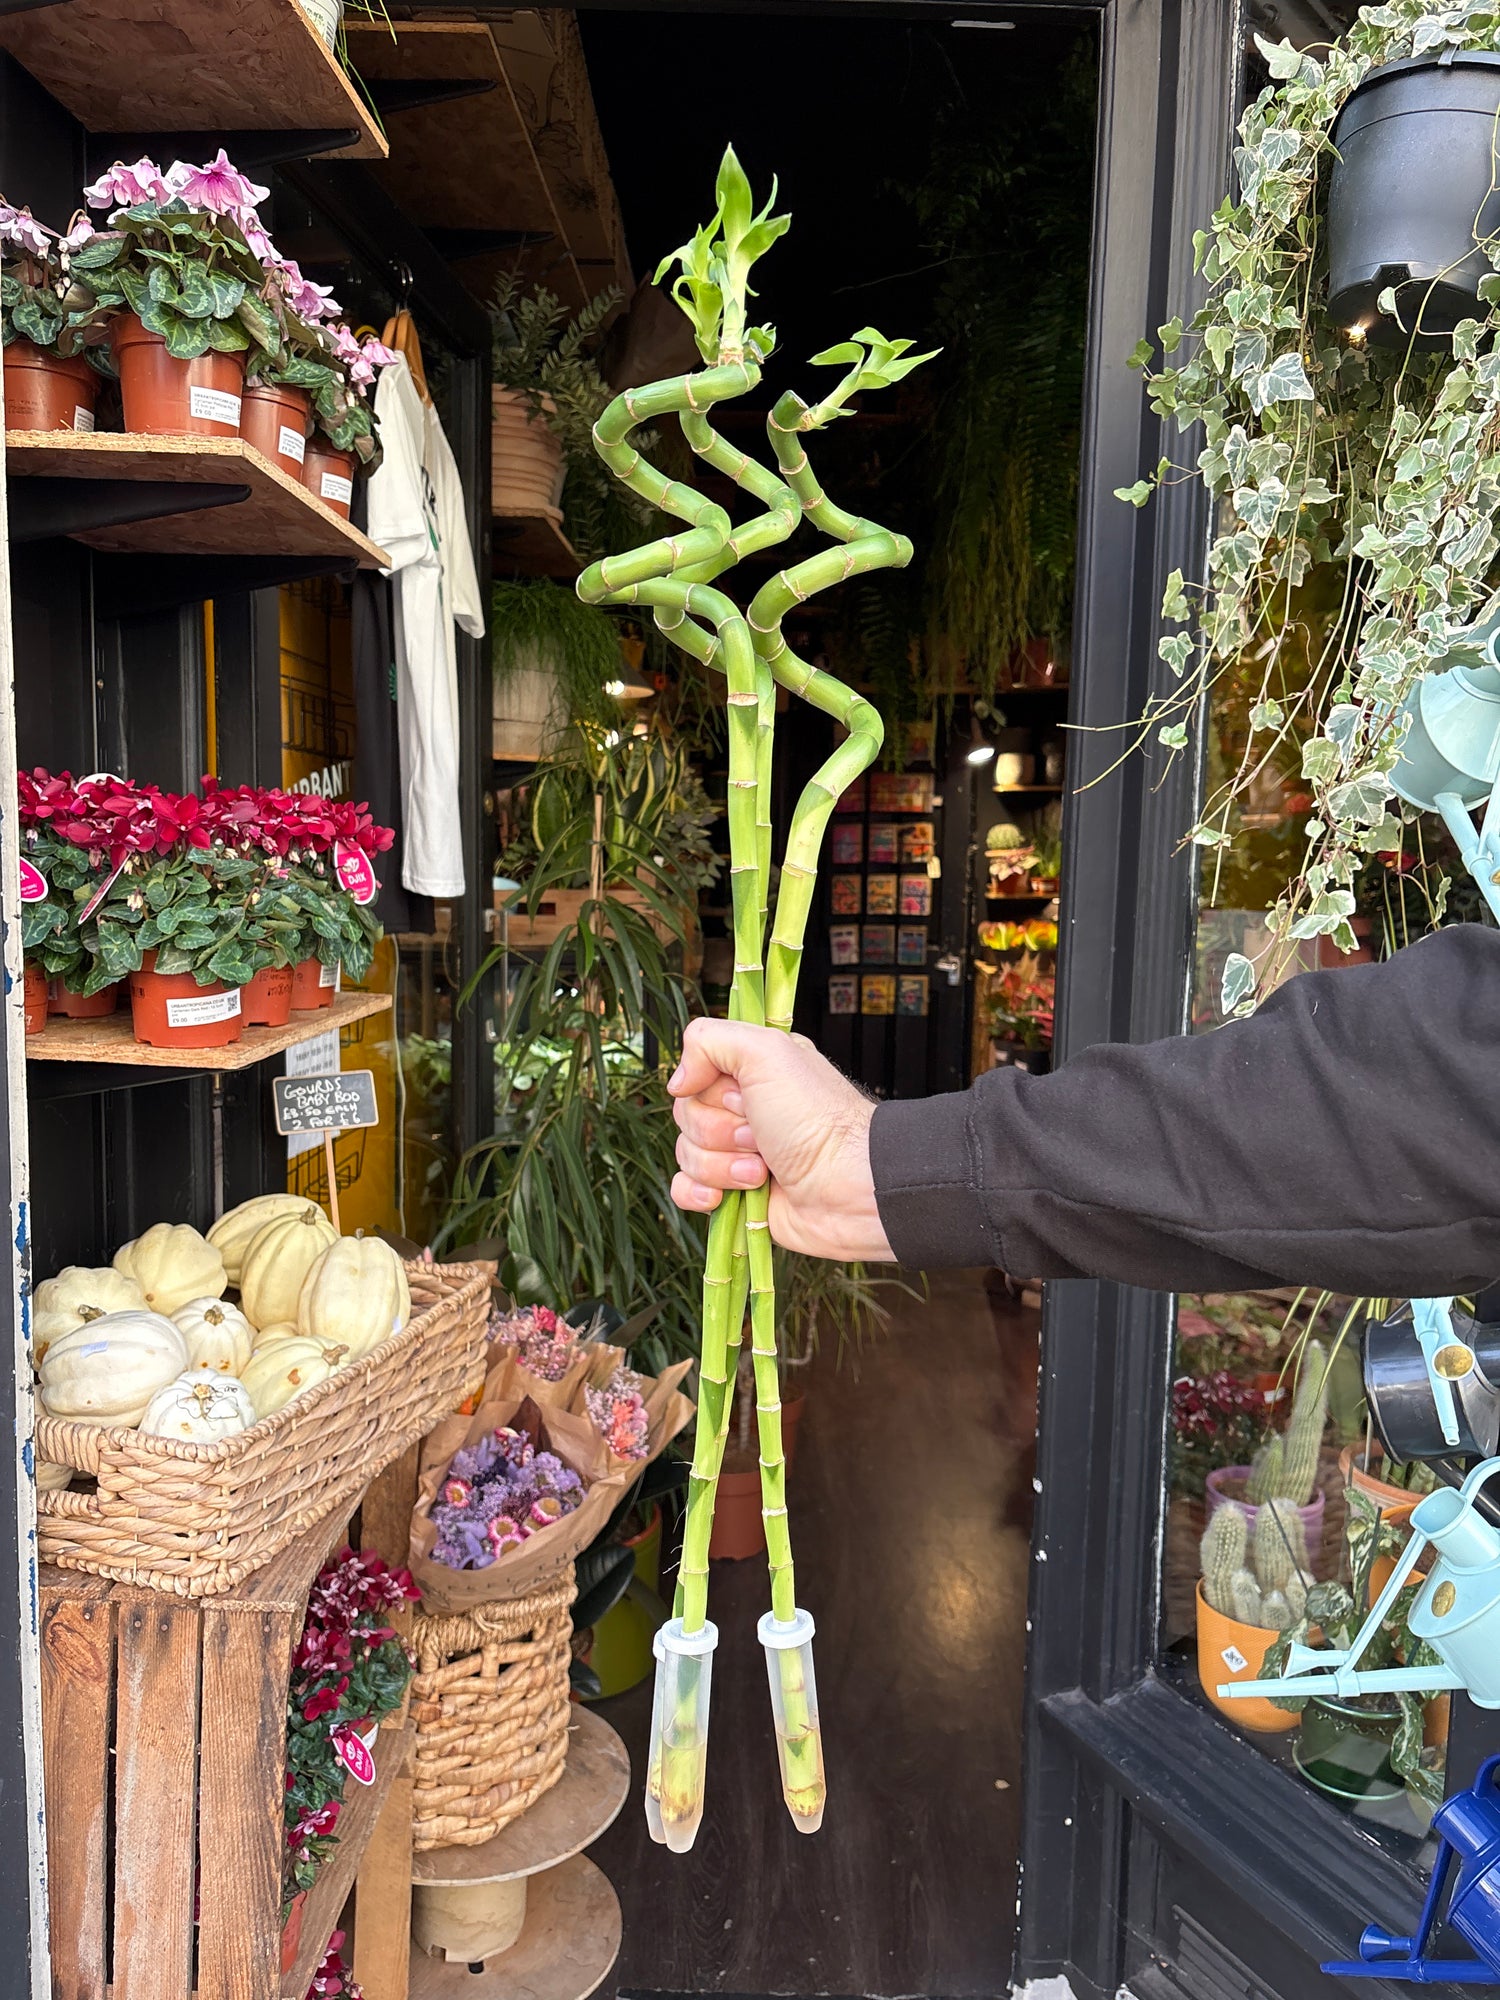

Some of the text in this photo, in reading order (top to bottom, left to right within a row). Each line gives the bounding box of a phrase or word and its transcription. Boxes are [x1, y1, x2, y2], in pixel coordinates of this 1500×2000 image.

[284, 1077, 341, 1099] GOURDS
[297, 1093, 330, 1109] BABY
[325, 1102, 358, 1115] EACH
[292, 1119, 304, 1130] 2
[309, 1116, 333, 1128] FOR
